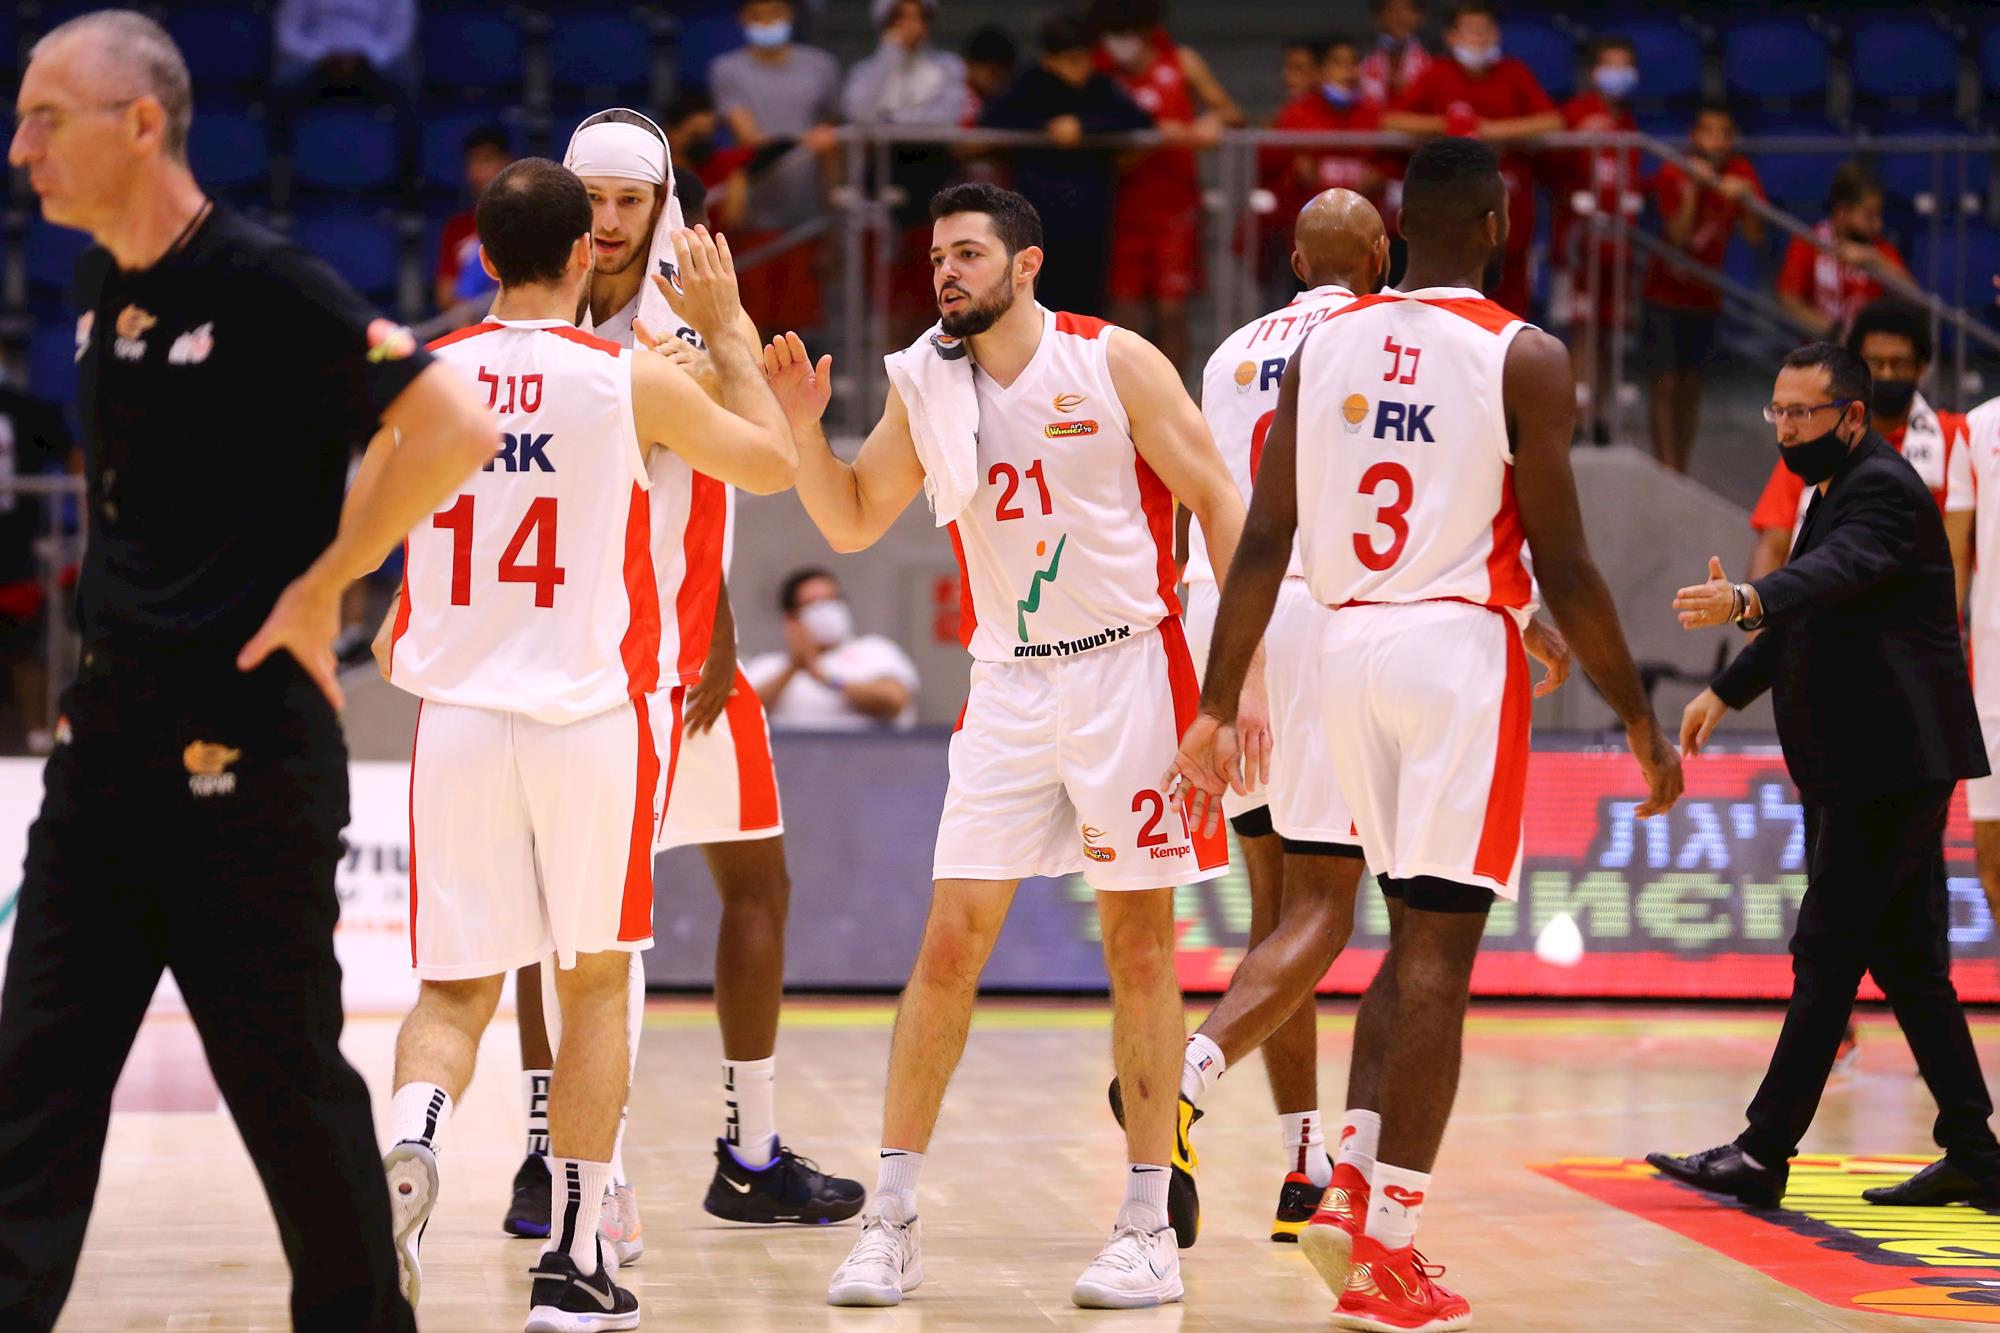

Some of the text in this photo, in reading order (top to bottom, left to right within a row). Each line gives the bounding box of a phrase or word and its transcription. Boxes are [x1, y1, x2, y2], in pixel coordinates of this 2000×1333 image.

[478, 366, 543, 413] סגל
[1050, 427, 1083, 436] Winner
[1373, 400, 1436, 443] RK
[483, 432, 556, 472] RK
[988, 459, 1053, 522] 21
[1353, 461, 1414, 572] 3
[433, 494, 566, 608] 14
